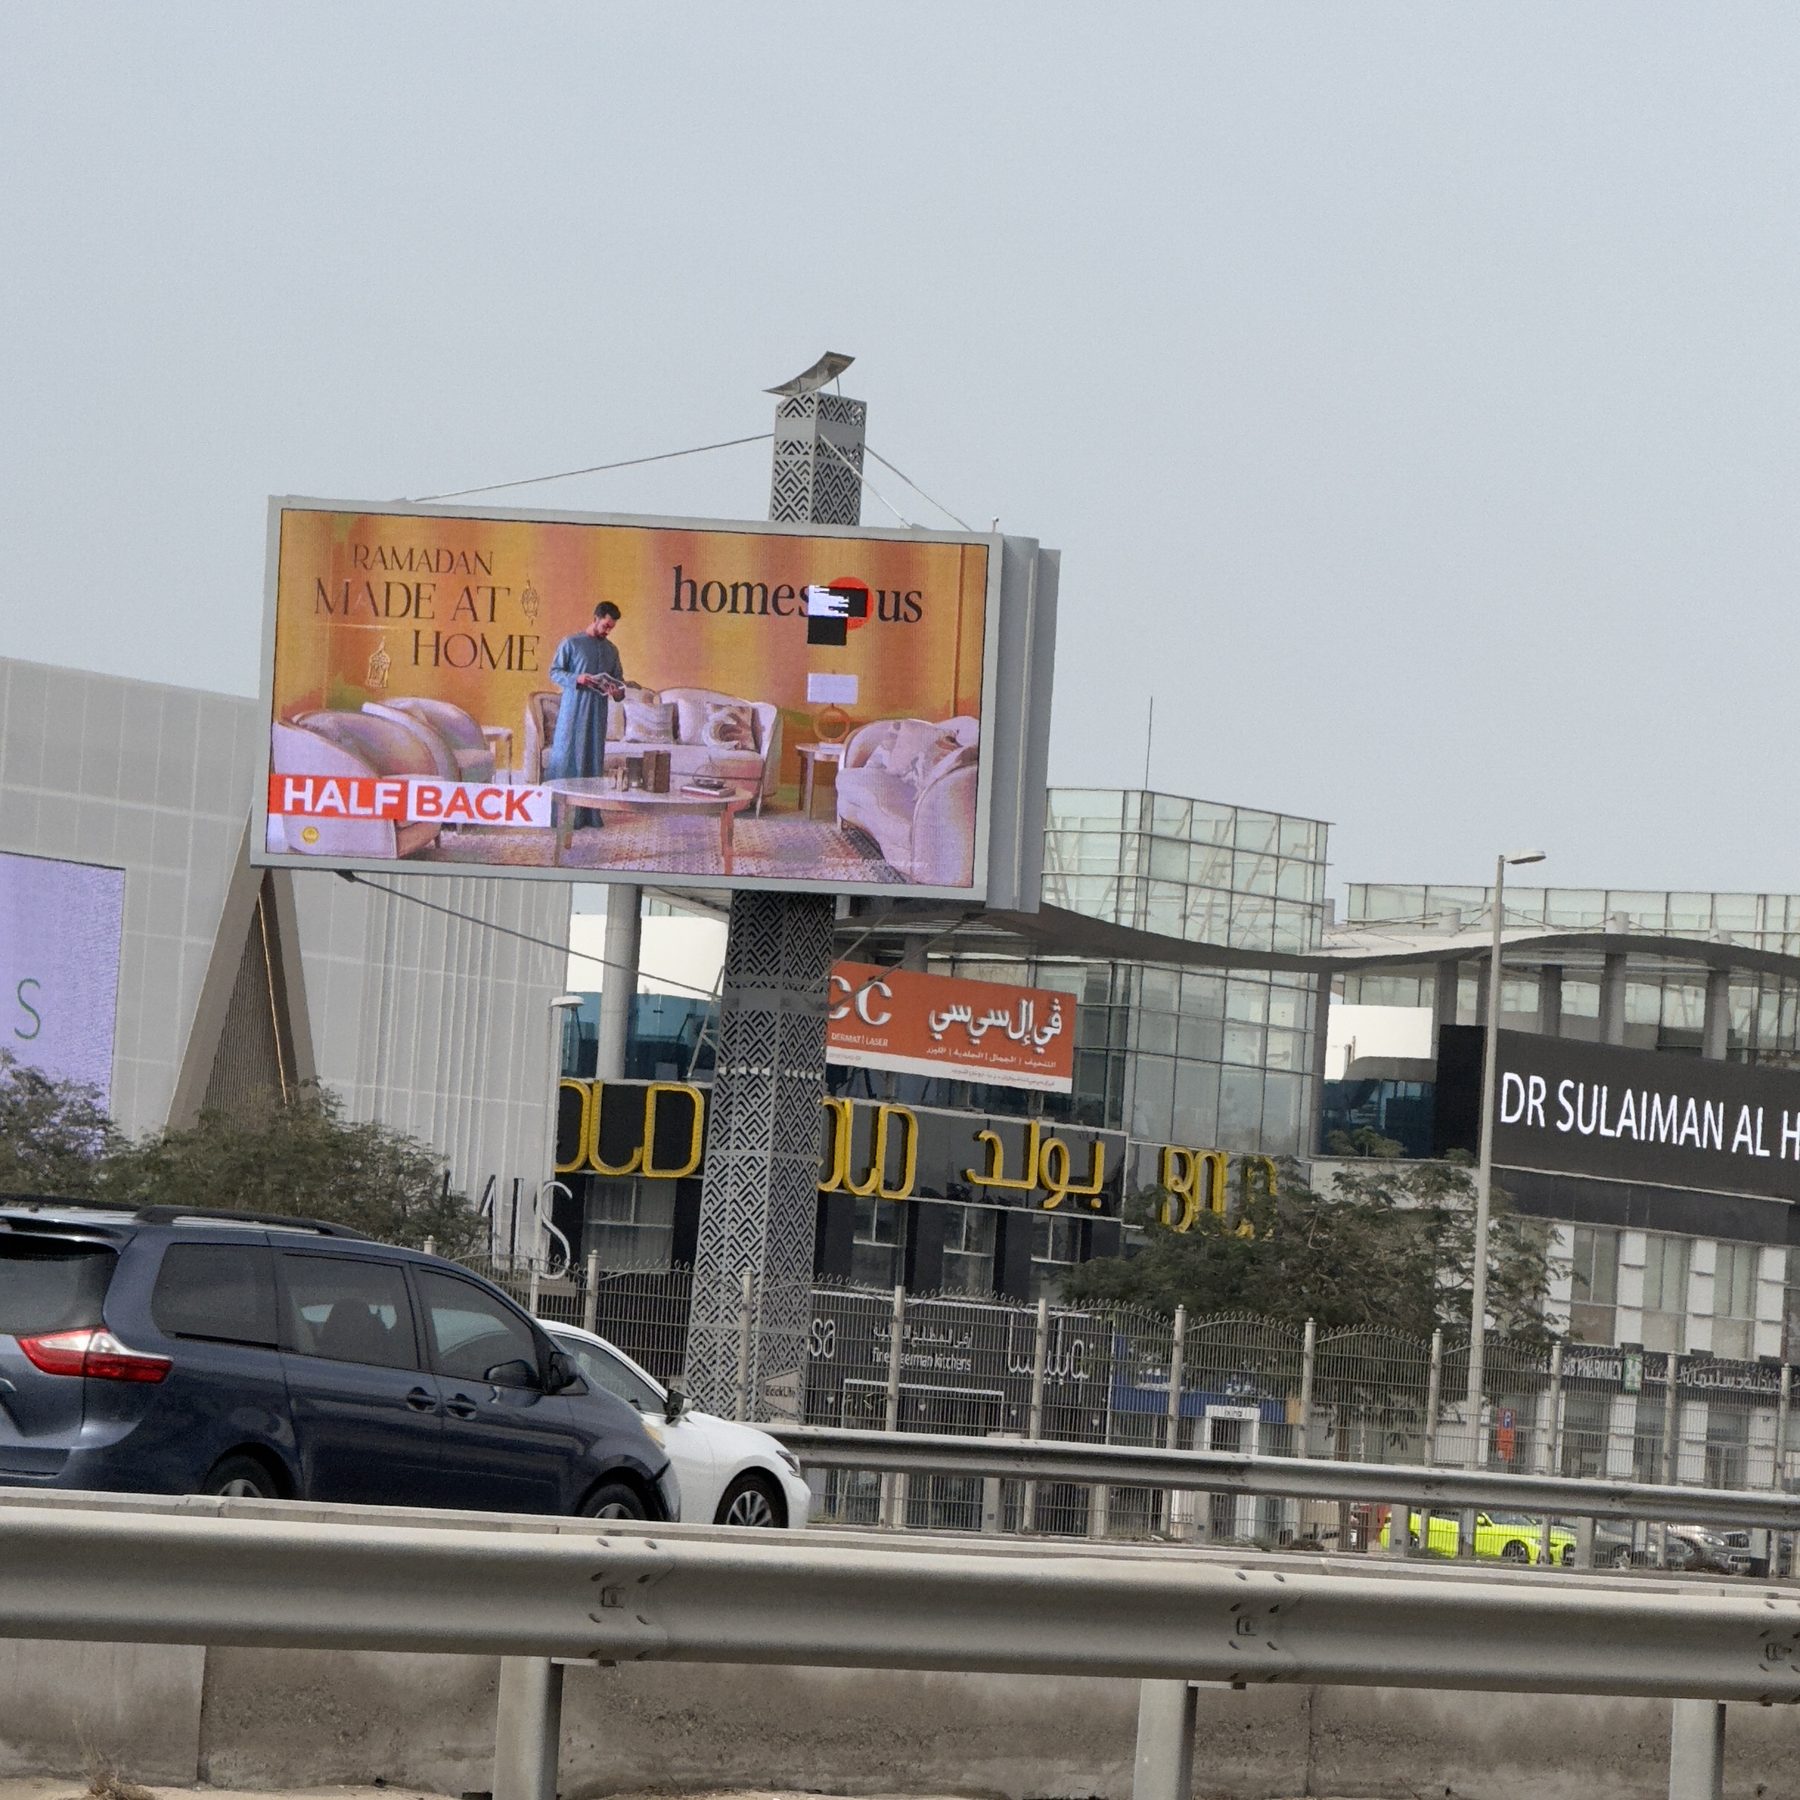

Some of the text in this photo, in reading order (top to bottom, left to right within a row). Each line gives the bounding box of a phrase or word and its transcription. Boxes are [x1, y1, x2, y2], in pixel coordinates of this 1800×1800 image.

[353, 544, 494, 576] RAMADAN
[314, 577, 511, 622] MADE AT
[876, 588, 923, 622] us
[412, 629, 540, 672] HOME
[283, 777, 400, 817] HALF
[14, 978, 41, 1040] S
[865, 1037, 888, 1047] LASER
[1500, 1072, 1546, 1128] DR
[1556, 1079, 1724, 1151] SULAIMAN
[1731, 1104, 1771, 1157] AL
[807, 1317, 836, 1359] sa
[1577, 1358, 1621, 1380] PHARMACY
